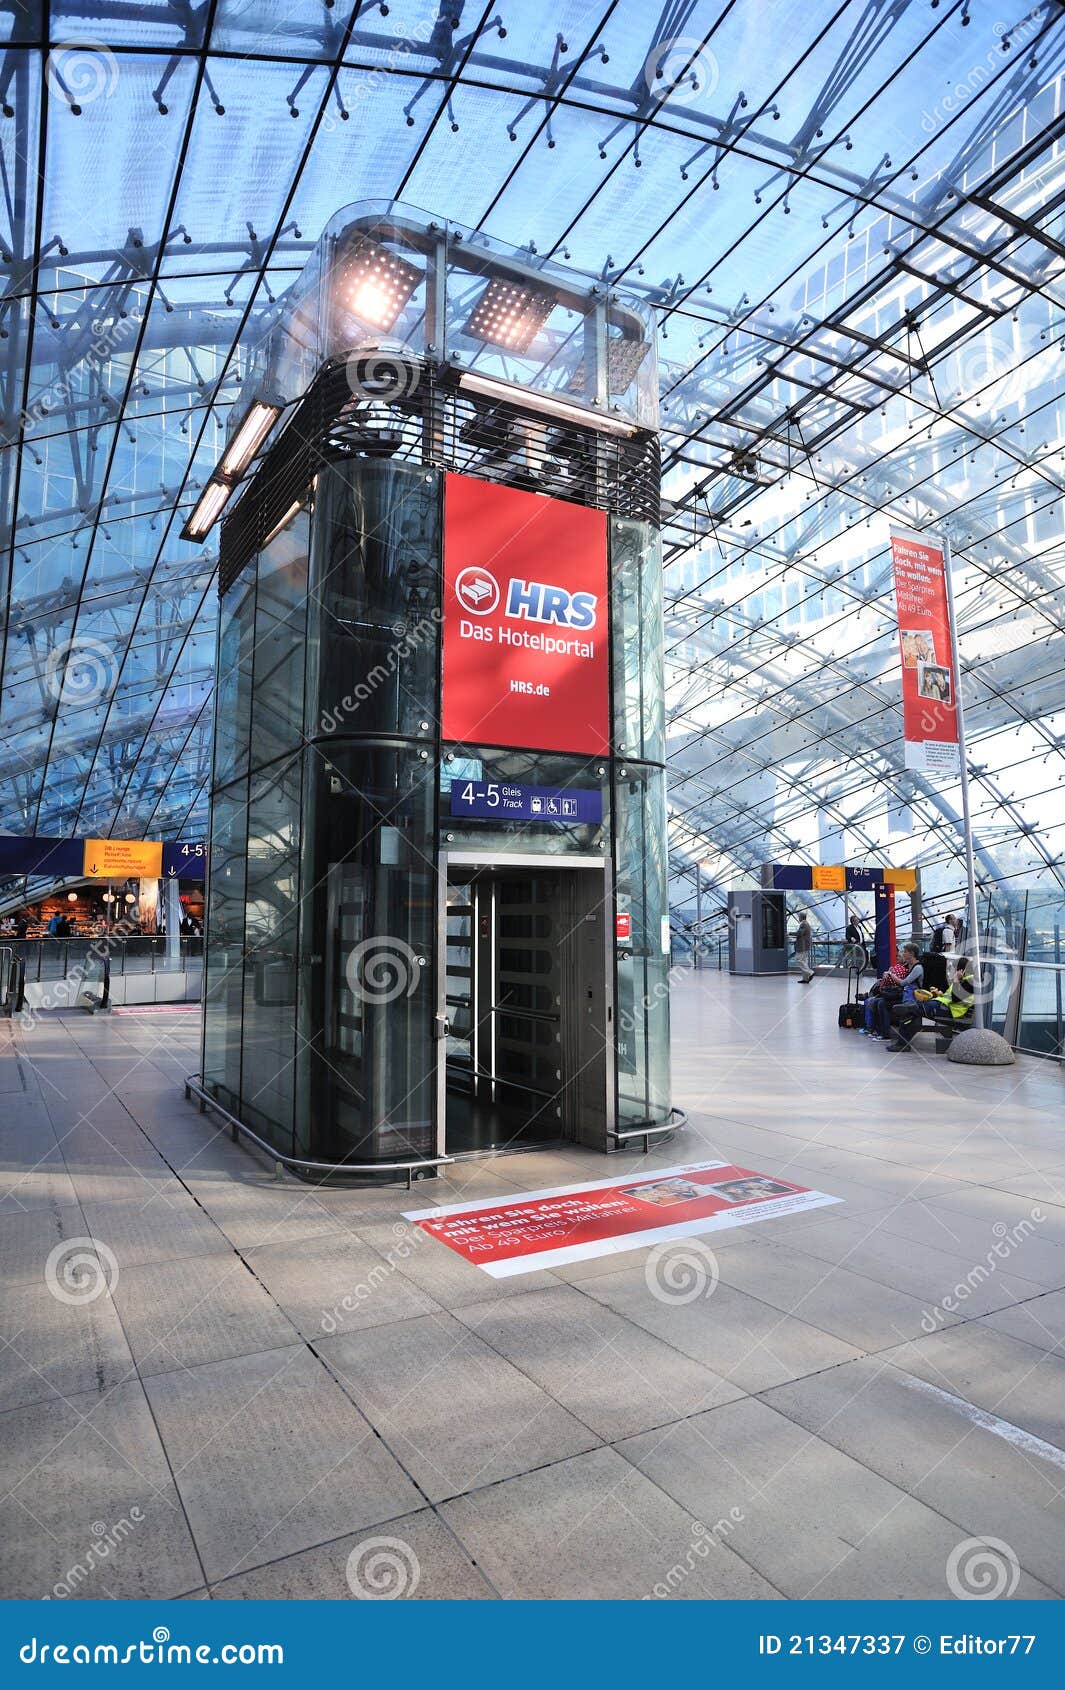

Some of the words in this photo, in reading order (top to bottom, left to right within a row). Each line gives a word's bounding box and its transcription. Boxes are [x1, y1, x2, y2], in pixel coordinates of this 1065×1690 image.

[505, 578, 598, 630] HRS
[460, 620, 493, 642] Das
[498, 626, 594, 658] Hotelportal
[510, 680, 550, 696] HRS.de
[461, 782, 500, 806] 4-5
[502, 787, 522, 796] Gleis
[502, 799, 523, 808] Track
[182, 844, 203, 856] 4-5
[432, 1214, 504, 1231] Fahren
[504, 1208, 534, 1218] Sie
[538, 1199, 590, 1212] doch,
[443, 1226, 477, 1238] mit
[482, 1220, 530, 1232] wem
[532, 1212, 561, 1222] Sie
[564, 1200, 629, 1215] wollen:
[452, 1235, 485, 1246] Der
[488, 1219, 567, 1238] Sparpreis
[468, 1240, 494, 1253] Ab
[498, 1236, 520, 1246] 49
[523, 1228, 570, 1242] Euro.
